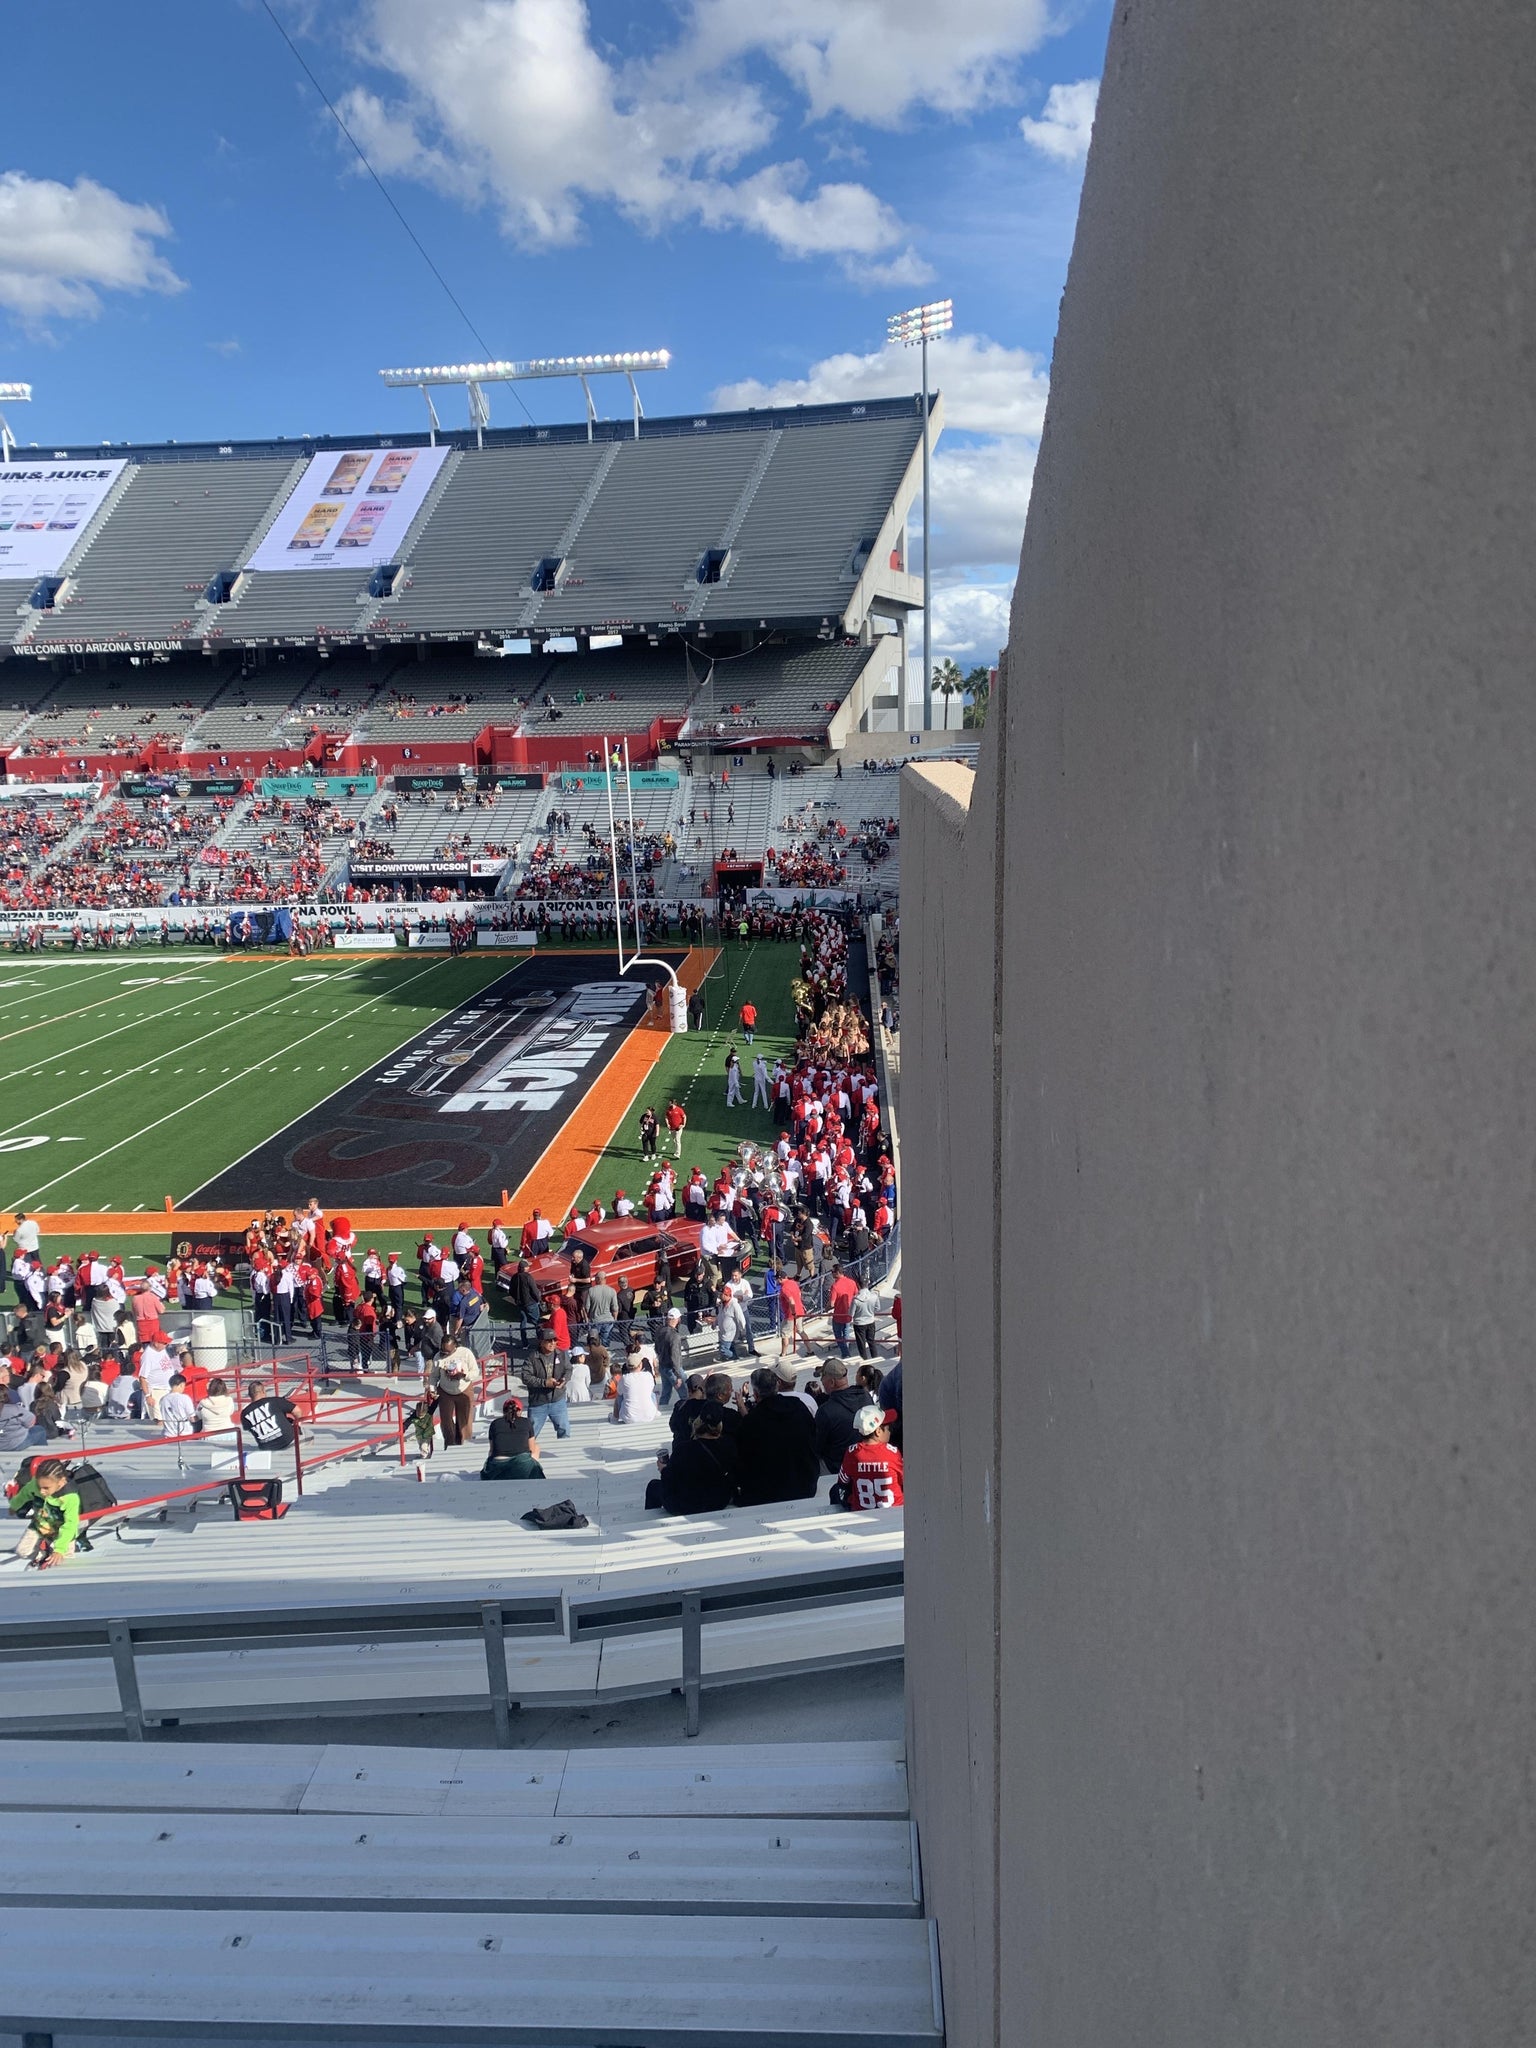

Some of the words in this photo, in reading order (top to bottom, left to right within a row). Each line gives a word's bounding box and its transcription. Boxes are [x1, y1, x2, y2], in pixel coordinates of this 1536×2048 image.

[54, 451, 68, 459] 204
[218, 446, 233, 454] 205
[13, 643, 66, 655] WELCOME
[68, 643, 83, 653] TO
[86, 642, 131, 652] ARIZONA
[134, 640, 182, 650] STADIUM
[912, 736, 918, 744] 8
[404, 748, 410, 758] 6
[614, 744, 620, 752] 7
[79, 760, 86, 769] 4
[220, 756, 227, 765] 5
[350, 865, 373, 873] VISIT
[375, 863, 431, 872] DOWNTOWN
[432, 862, 468, 871] TUCSON
[537, 901, 593, 912] ARIZONA
[375, 1049, 434, 1085] SNOOP
[245, 1402, 272, 1426] YAY
[251, 1415, 278, 1437] YAY
[857, 1462, 889, 1473] KITTLE
[856, 1476, 895, 1509] 85
[488, 1582, 503, 1590] 29
[577, 1578, 592, 1586] 28
[231, 1936, 243, 1948] 3
